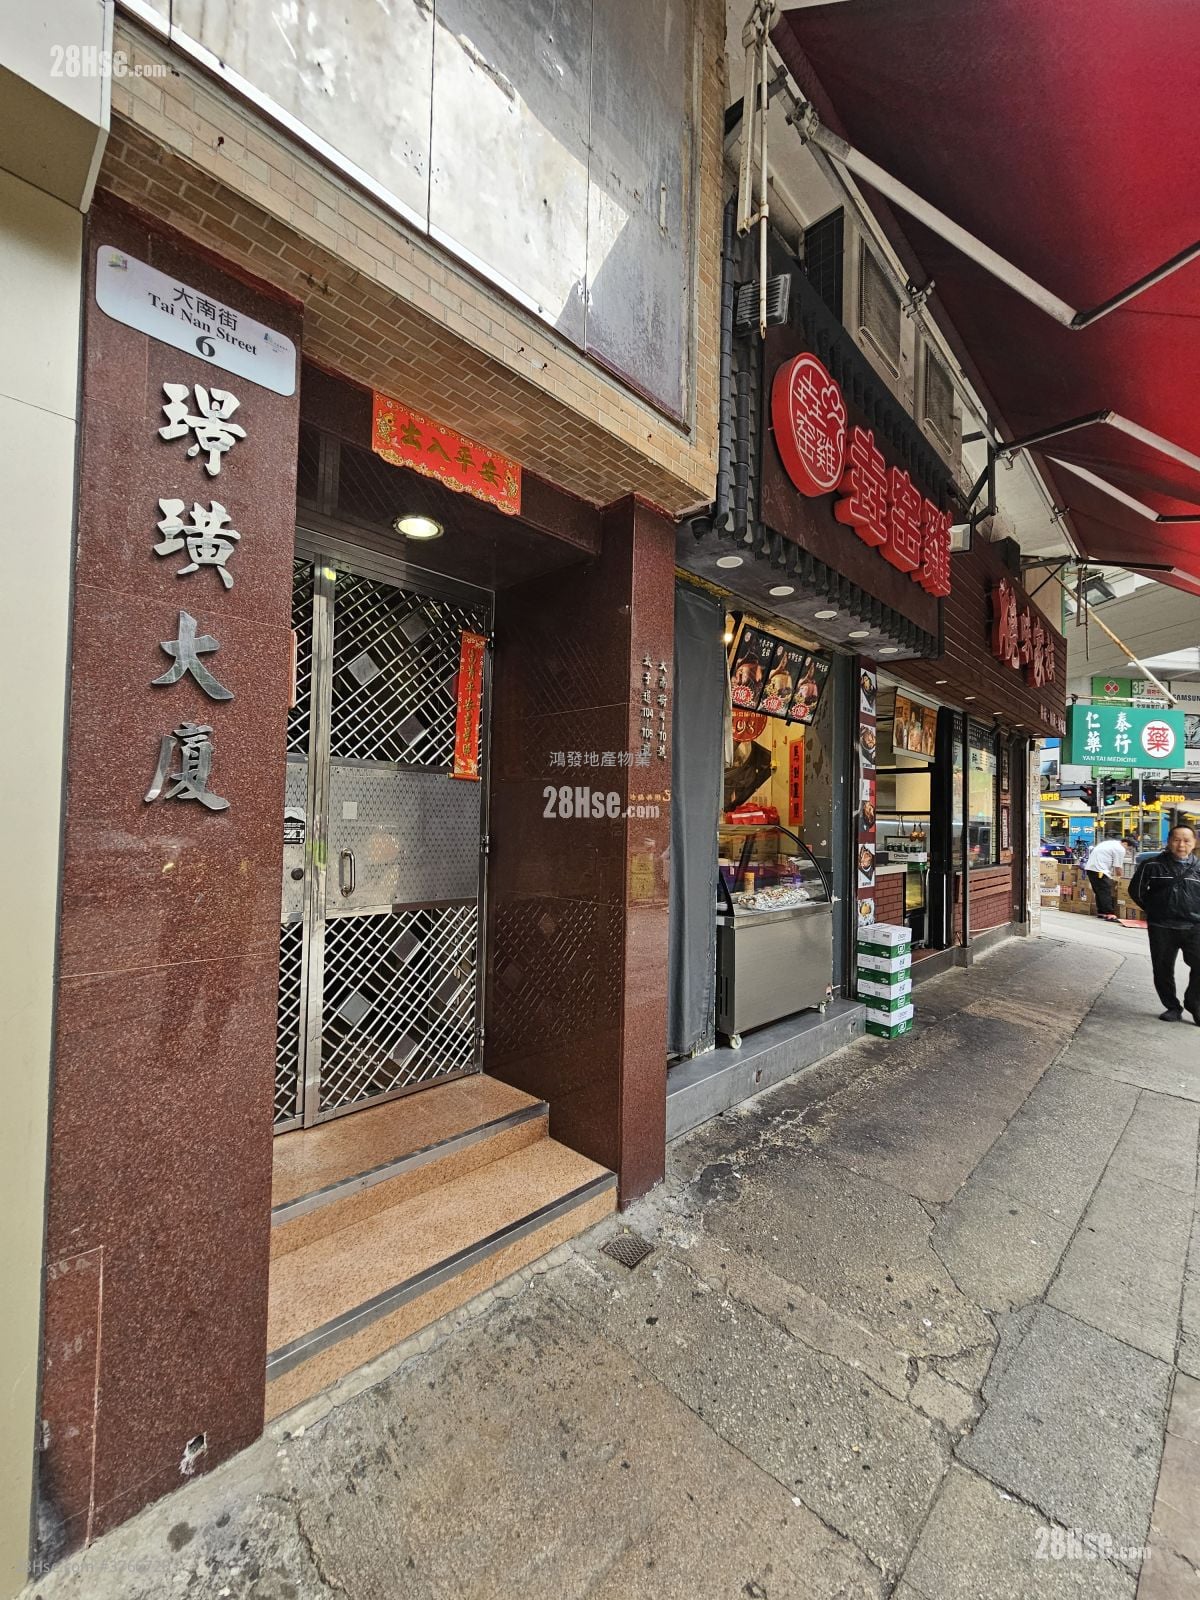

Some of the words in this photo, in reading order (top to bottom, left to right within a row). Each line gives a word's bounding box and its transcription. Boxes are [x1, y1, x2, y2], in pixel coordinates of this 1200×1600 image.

[148, 292, 175, 316] Tai
[180, 308, 211, 334] Nan
[216, 327, 258, 356] Street
[173, 287, 238, 331] 大南街
[195, 335, 216, 357] 6
[400, 418, 502, 488] 出入平安
[1147, 726, 1169, 752] 藥
[1160, 794, 1185, 802] BISTRO
